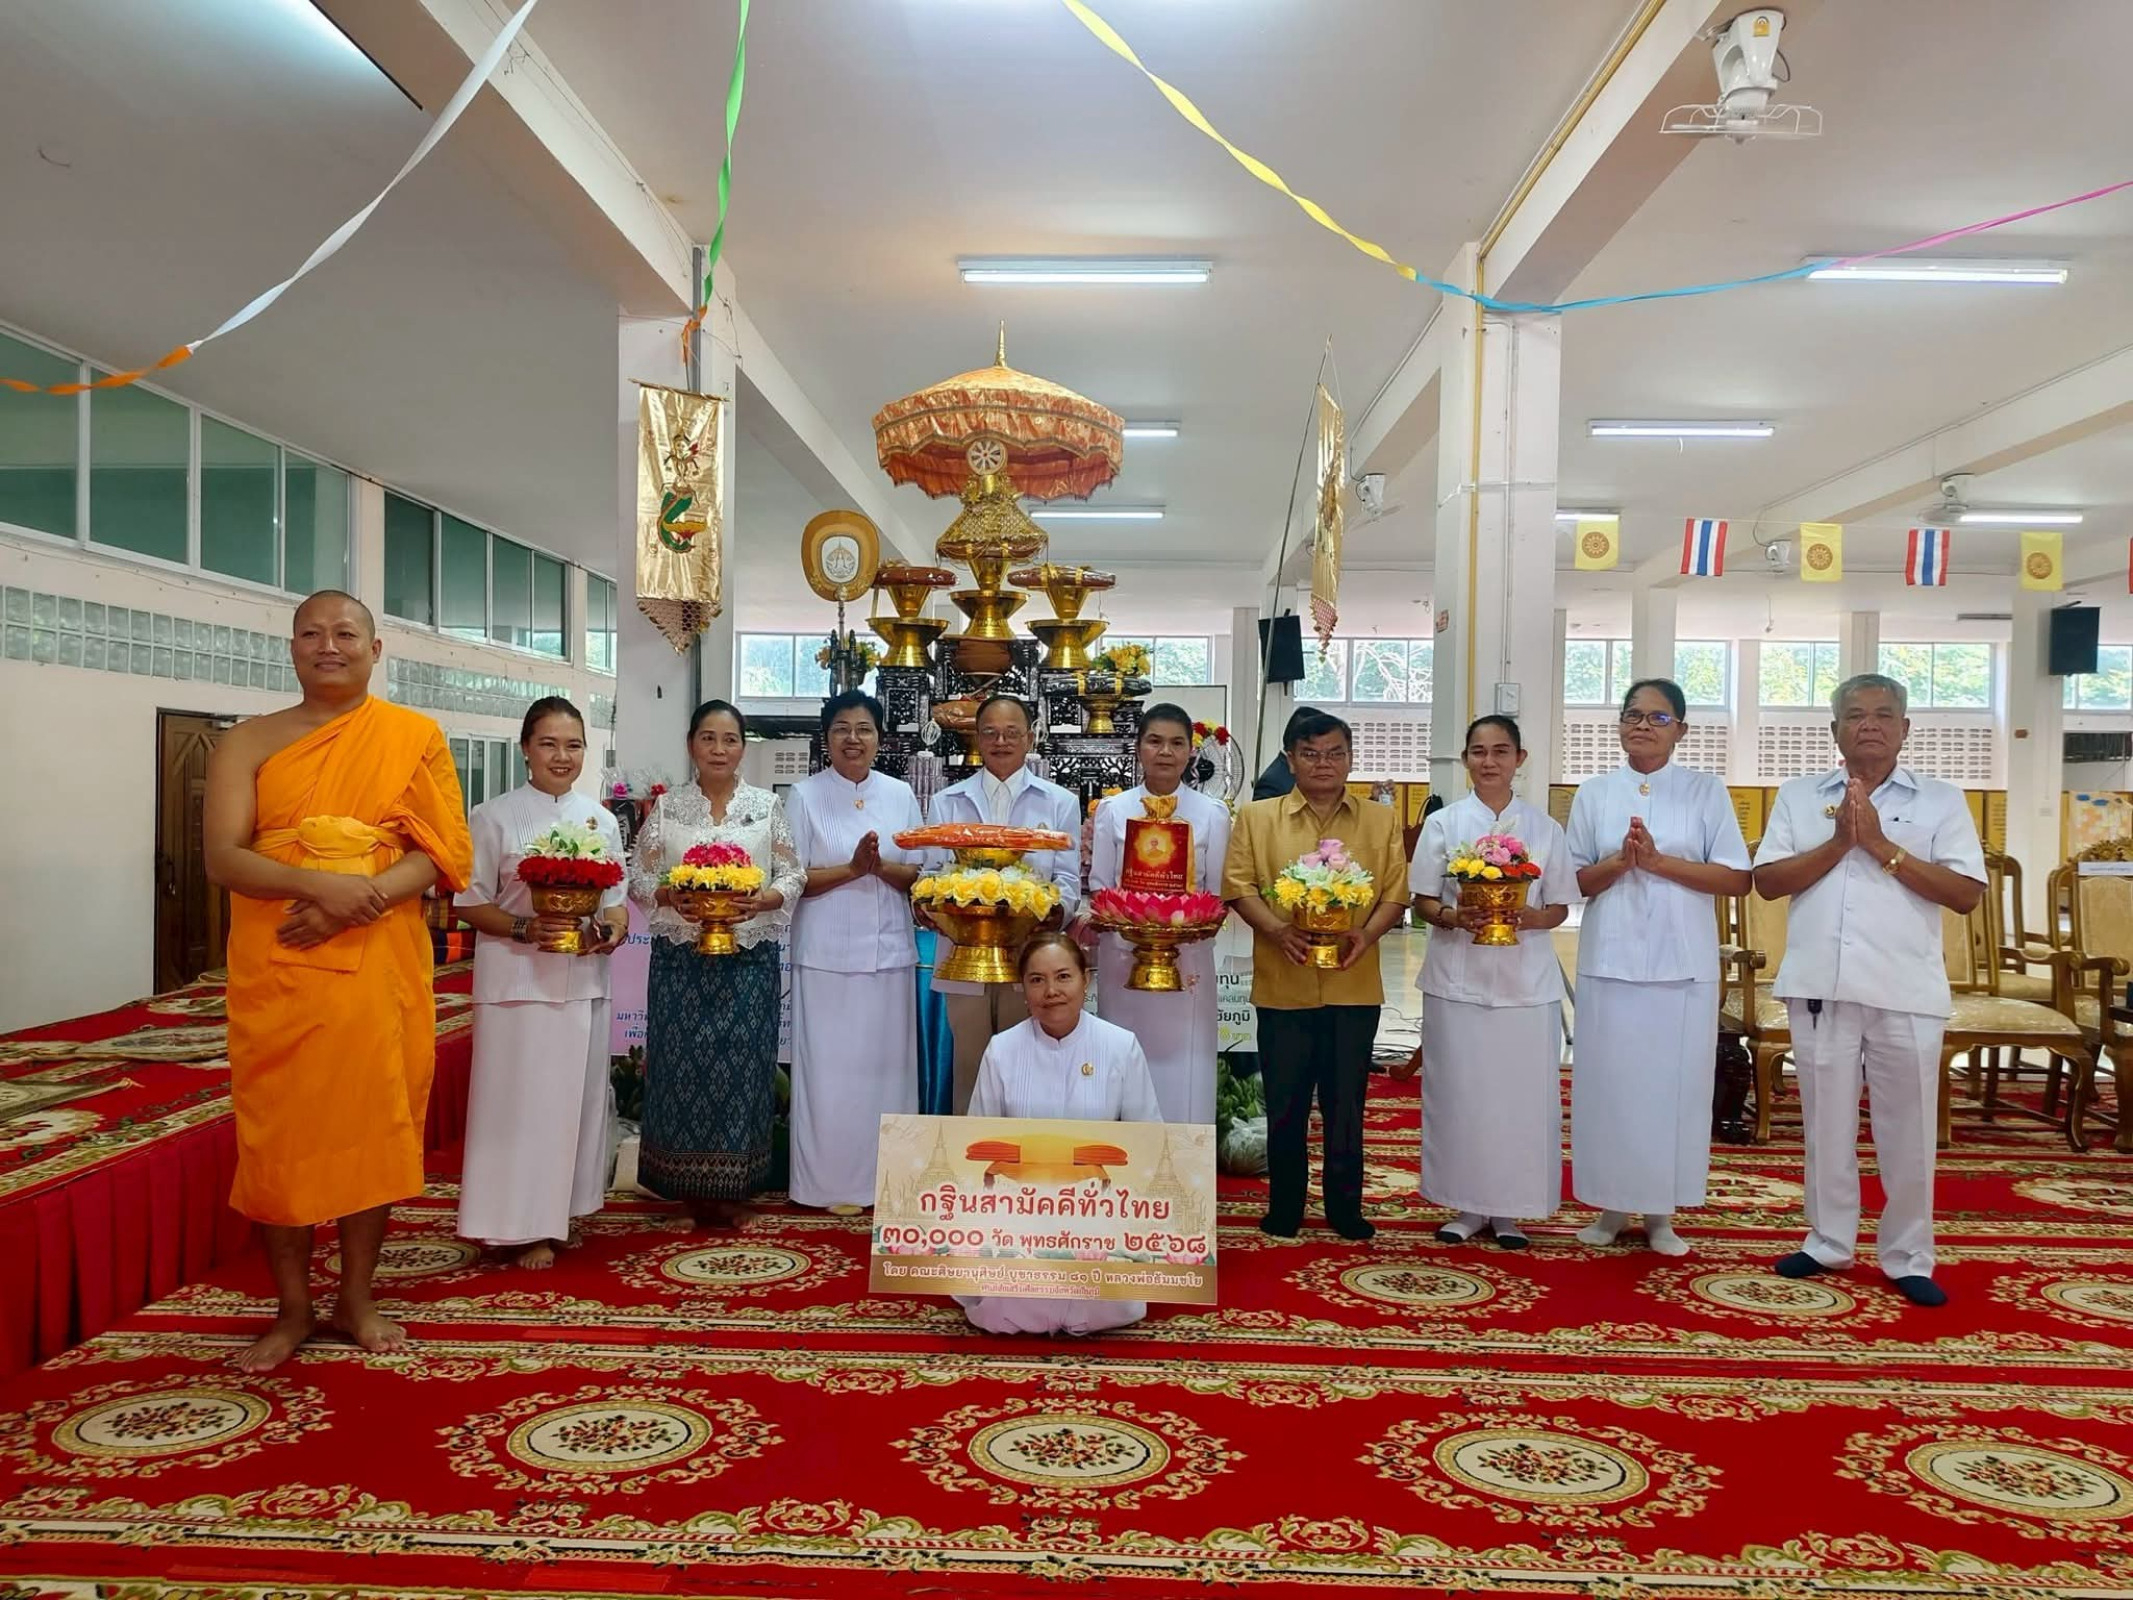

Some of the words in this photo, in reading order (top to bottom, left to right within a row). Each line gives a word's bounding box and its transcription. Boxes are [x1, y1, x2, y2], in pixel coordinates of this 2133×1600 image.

[1216, 974, 1240, 989] ทุน
[920, 1182, 1170, 1221] กฐินสามัคคีทั่วไทย
[883, 1226, 984, 1248] ๓๐,๐๐๐
[992, 1228, 1014, 1247] วัด
[1020, 1230, 1116, 1254] พุทธศักราช
[1124, 1232, 1206, 1253] ๒๕๖๘
[883, 1261, 908, 1277] โดย
[910, 1263, 1005, 1282] คณะศิษยานุศิษย์
[1009, 1268, 1065, 1282] บูชาธรรม
[1069, 1271, 1087, 1283] ๘๑
[1091, 1268, 1101, 1282] ปี
[1105, 1271, 1203, 1286] หลวงพ่อธัมมชโย
